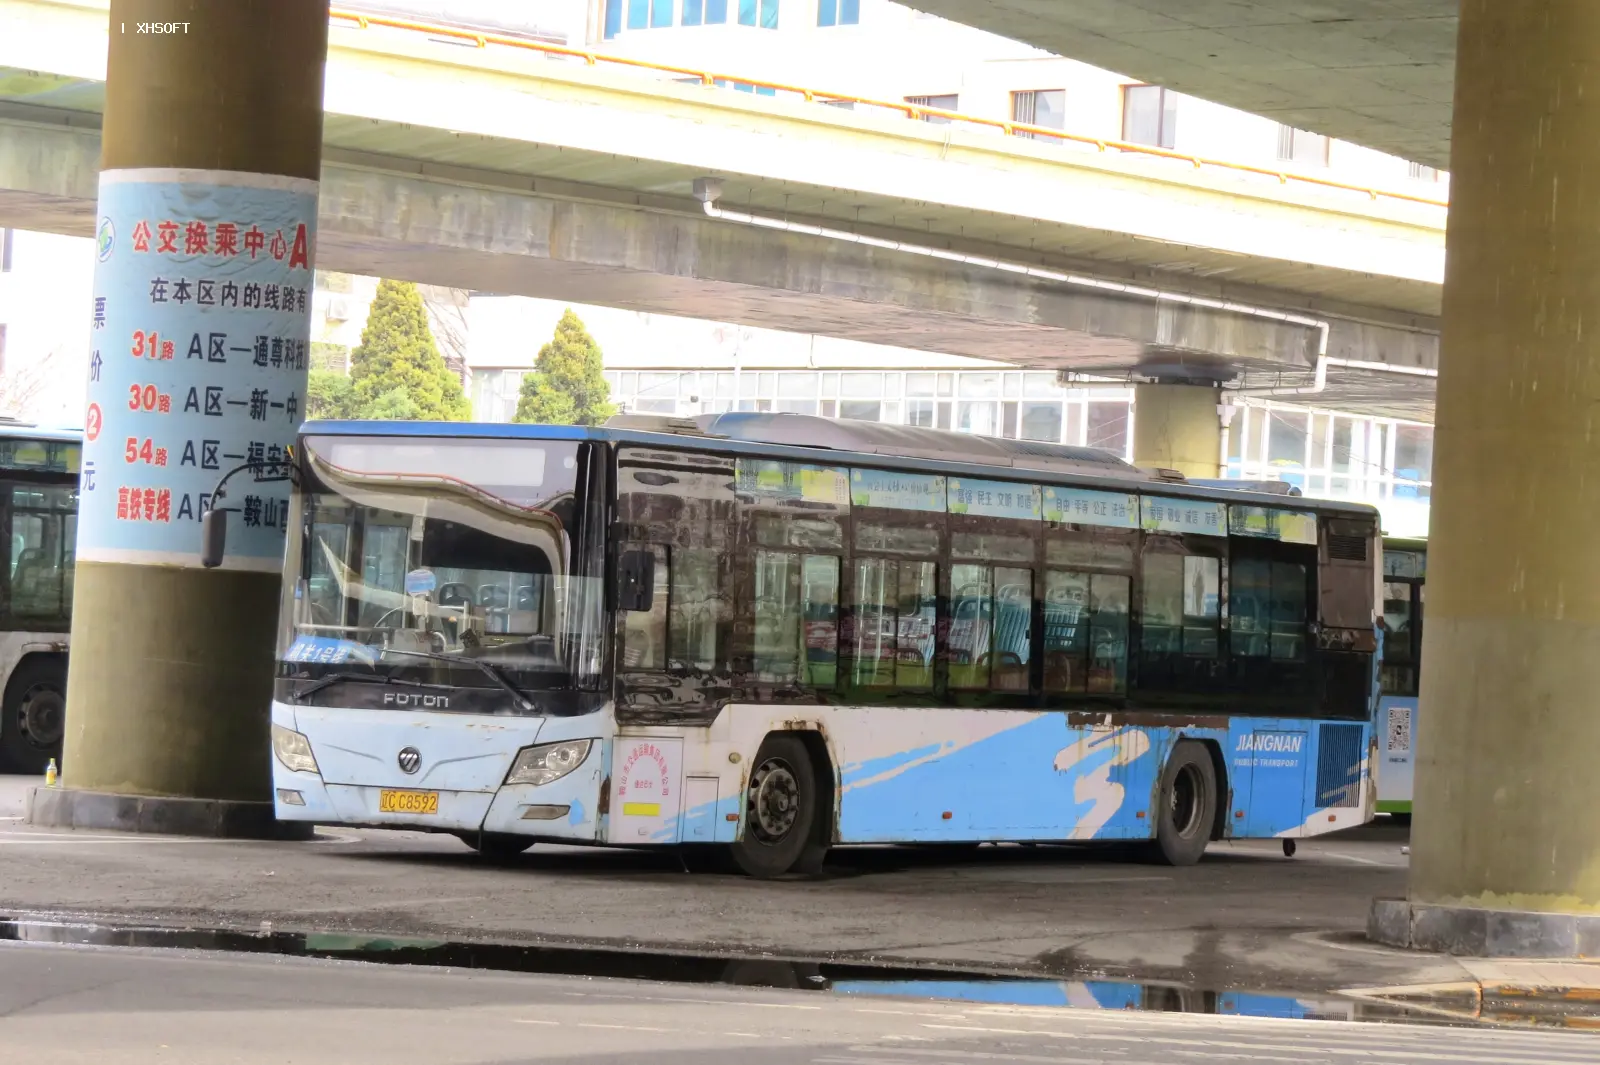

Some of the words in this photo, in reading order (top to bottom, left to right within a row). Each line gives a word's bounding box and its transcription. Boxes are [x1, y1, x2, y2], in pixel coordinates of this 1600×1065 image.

[132, 220, 308, 270] 公交换乘中心A
[150, 277, 306, 313] 在本区内的线路有
[131, 330, 175, 360] 31路
[128, 384, 171, 414] 30路
[125, 437, 168, 466] 54路
[116, 487, 171, 523] 高铁专线
[1235, 735, 1303, 753] JIANGNAN
[1234, 757, 1258, 768] PUBLIC
[1260, 759, 1299, 768] TRANSPORT
